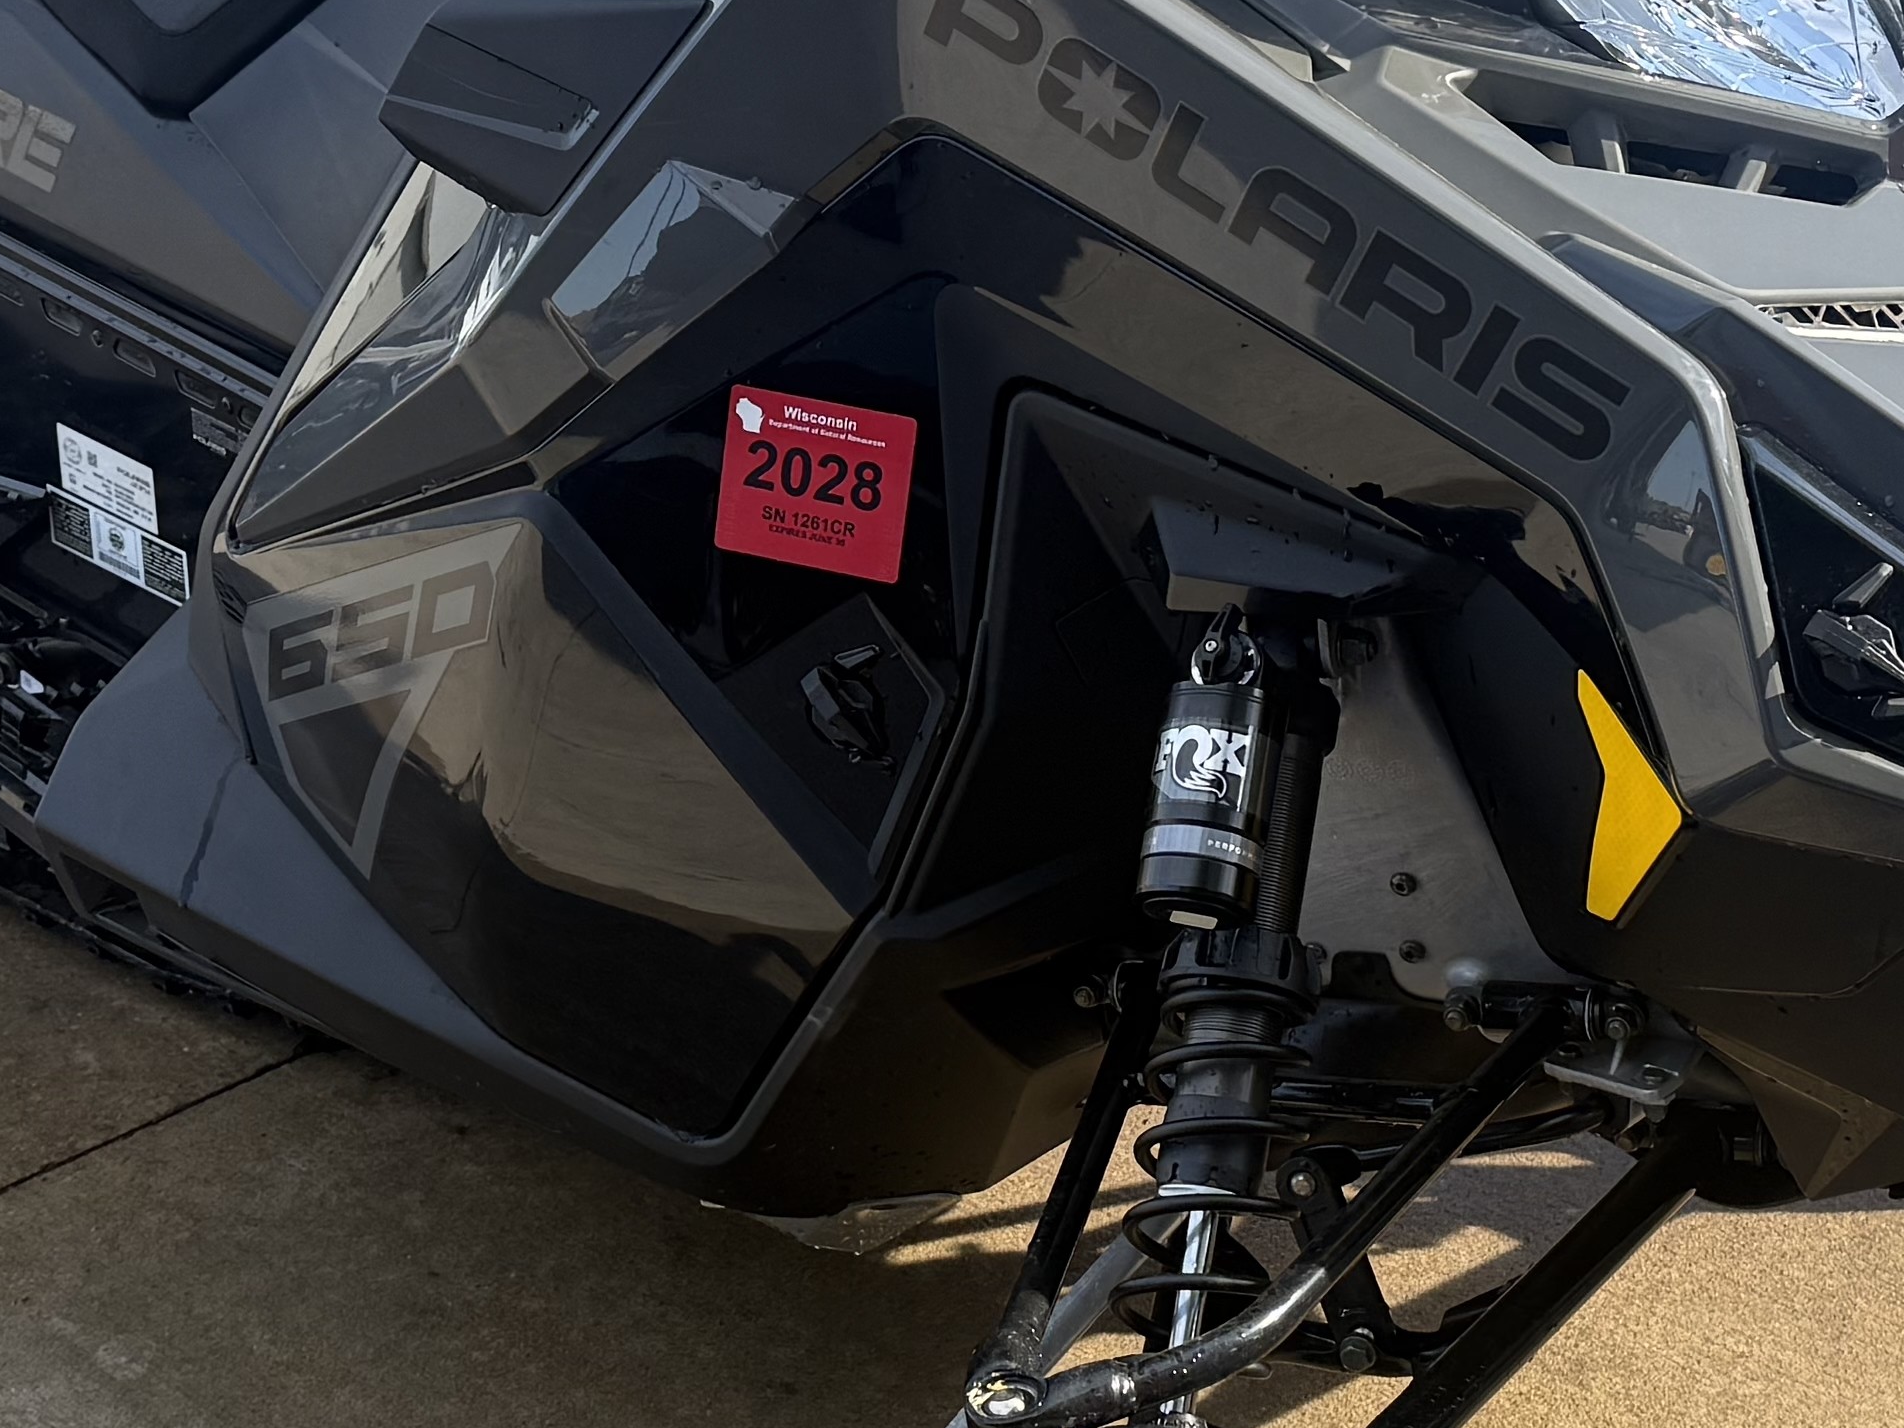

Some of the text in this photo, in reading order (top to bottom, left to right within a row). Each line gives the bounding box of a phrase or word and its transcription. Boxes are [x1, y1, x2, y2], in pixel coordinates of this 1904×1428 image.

[783, 405, 857, 432] Wisconsin
[743, 439, 884, 512] 2028
[761, 505, 855, 538] SN 1261CR
[268, 560, 496, 702] 650
[1154, 724, 1253, 796] FOX
